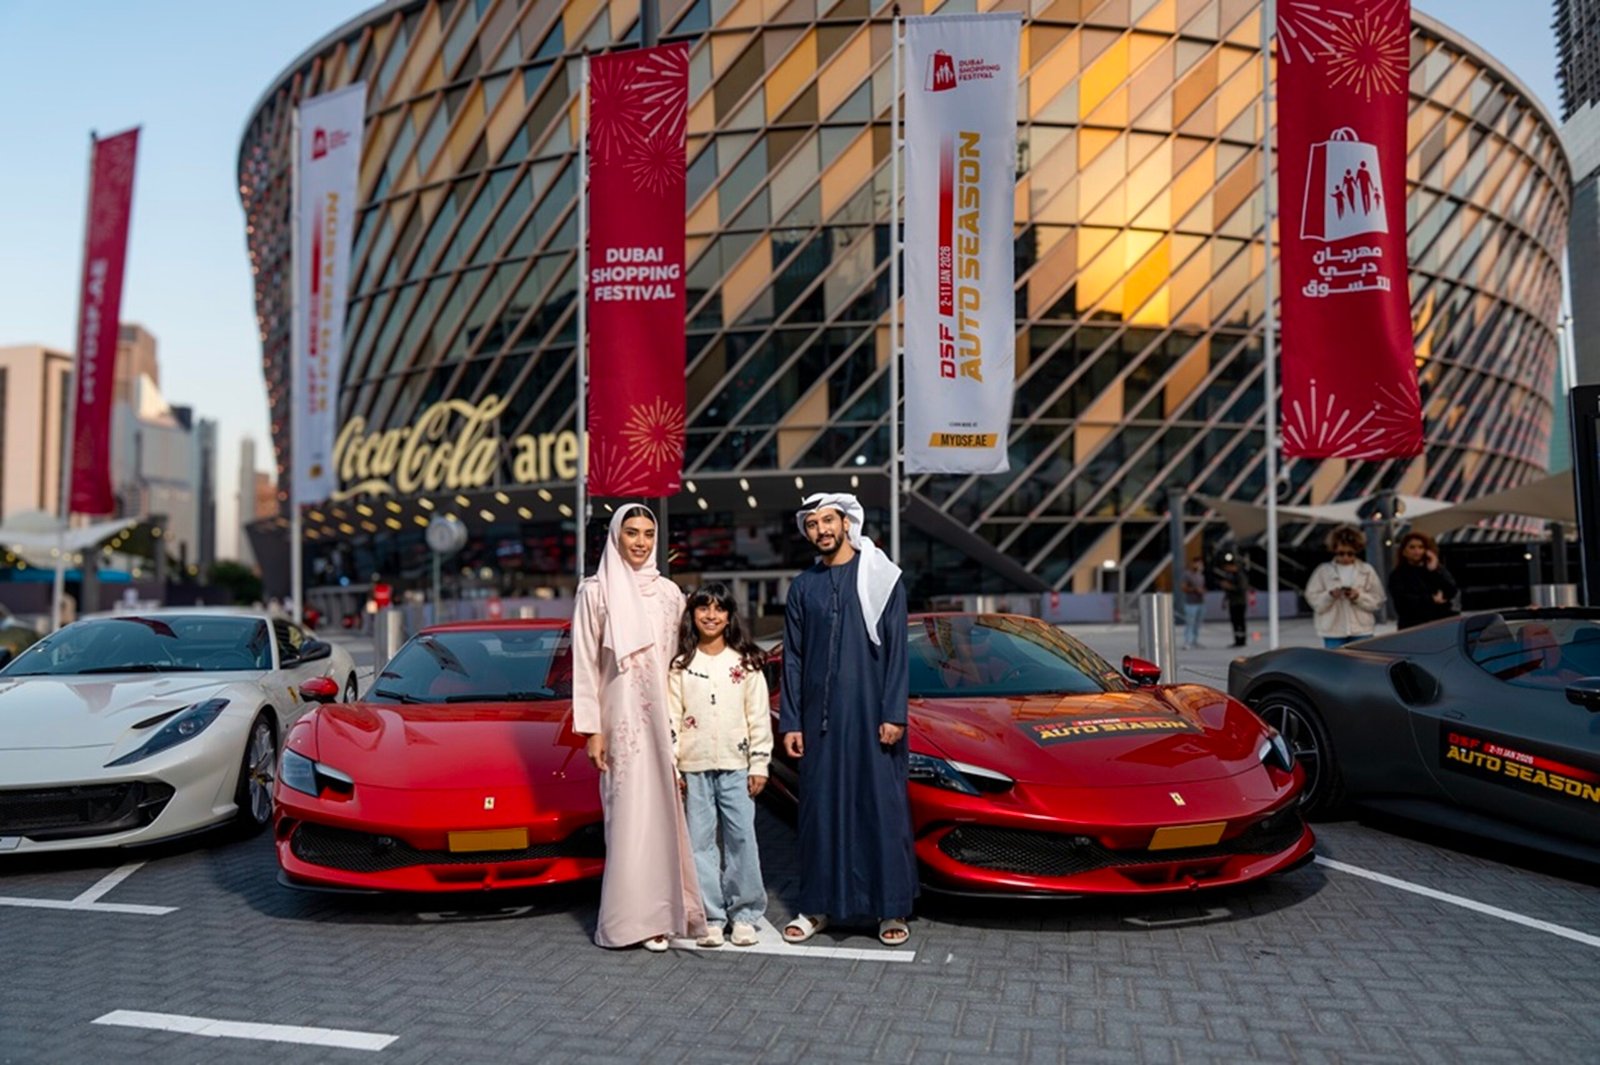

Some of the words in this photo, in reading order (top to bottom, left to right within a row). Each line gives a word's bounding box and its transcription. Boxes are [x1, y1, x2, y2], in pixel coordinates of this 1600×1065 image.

[959, 59, 984, 67] DUBAI
[959, 64, 1000, 73] SHOPPING
[959, 72, 994, 81] FESTIVAL
[958, 131, 981, 280] SEASON
[606, 246, 664, 263] DUBAI
[940, 245, 952, 268] 2026
[1312, 246, 1383, 265] مهرجان
[591, 263, 680, 284] SHOPPING
[940, 269, 952, 285] JAN
[1318, 261, 1379, 281] دبي
[594, 283, 676, 302] FESTIVAL
[958, 286, 983, 382] AUTO
[939, 323, 956, 379] DSF
[941, 433, 987, 447] MYDSF.AE
[514, 429, 589, 483] are
[1040, 726, 1099, 739] AUTO
[1099, 720, 1188, 732] SEASON
[1448, 732, 1481, 748] DSF
[1446, 745, 1502, 772] AUTO
[1504, 761, 1600, 803] SEASON
